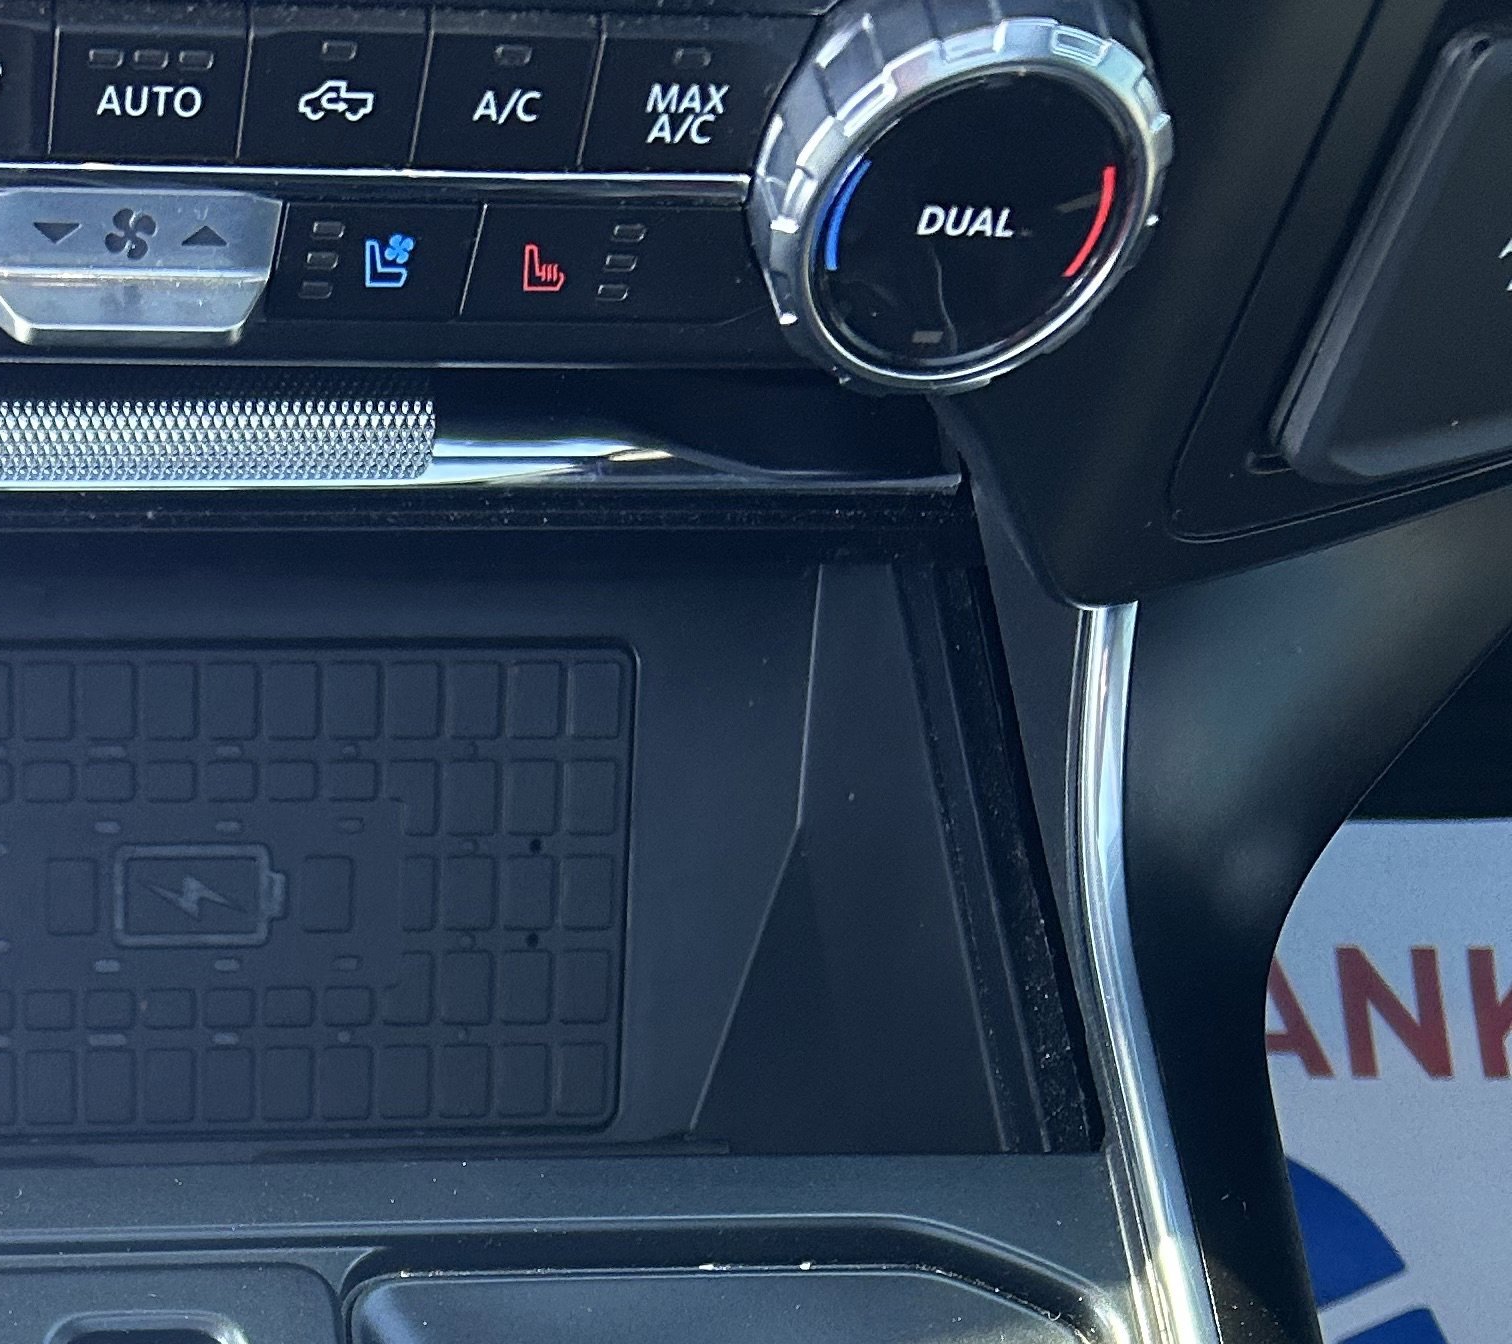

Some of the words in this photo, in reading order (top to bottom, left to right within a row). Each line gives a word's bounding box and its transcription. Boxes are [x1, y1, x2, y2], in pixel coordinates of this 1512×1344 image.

[96, 85, 202, 118] AUTO
[472, 89, 542, 125] A/C
[646, 84, 730, 115] MAX
[646, 114, 717, 145] A/C
[916, 205, 1015, 238] DUAL
